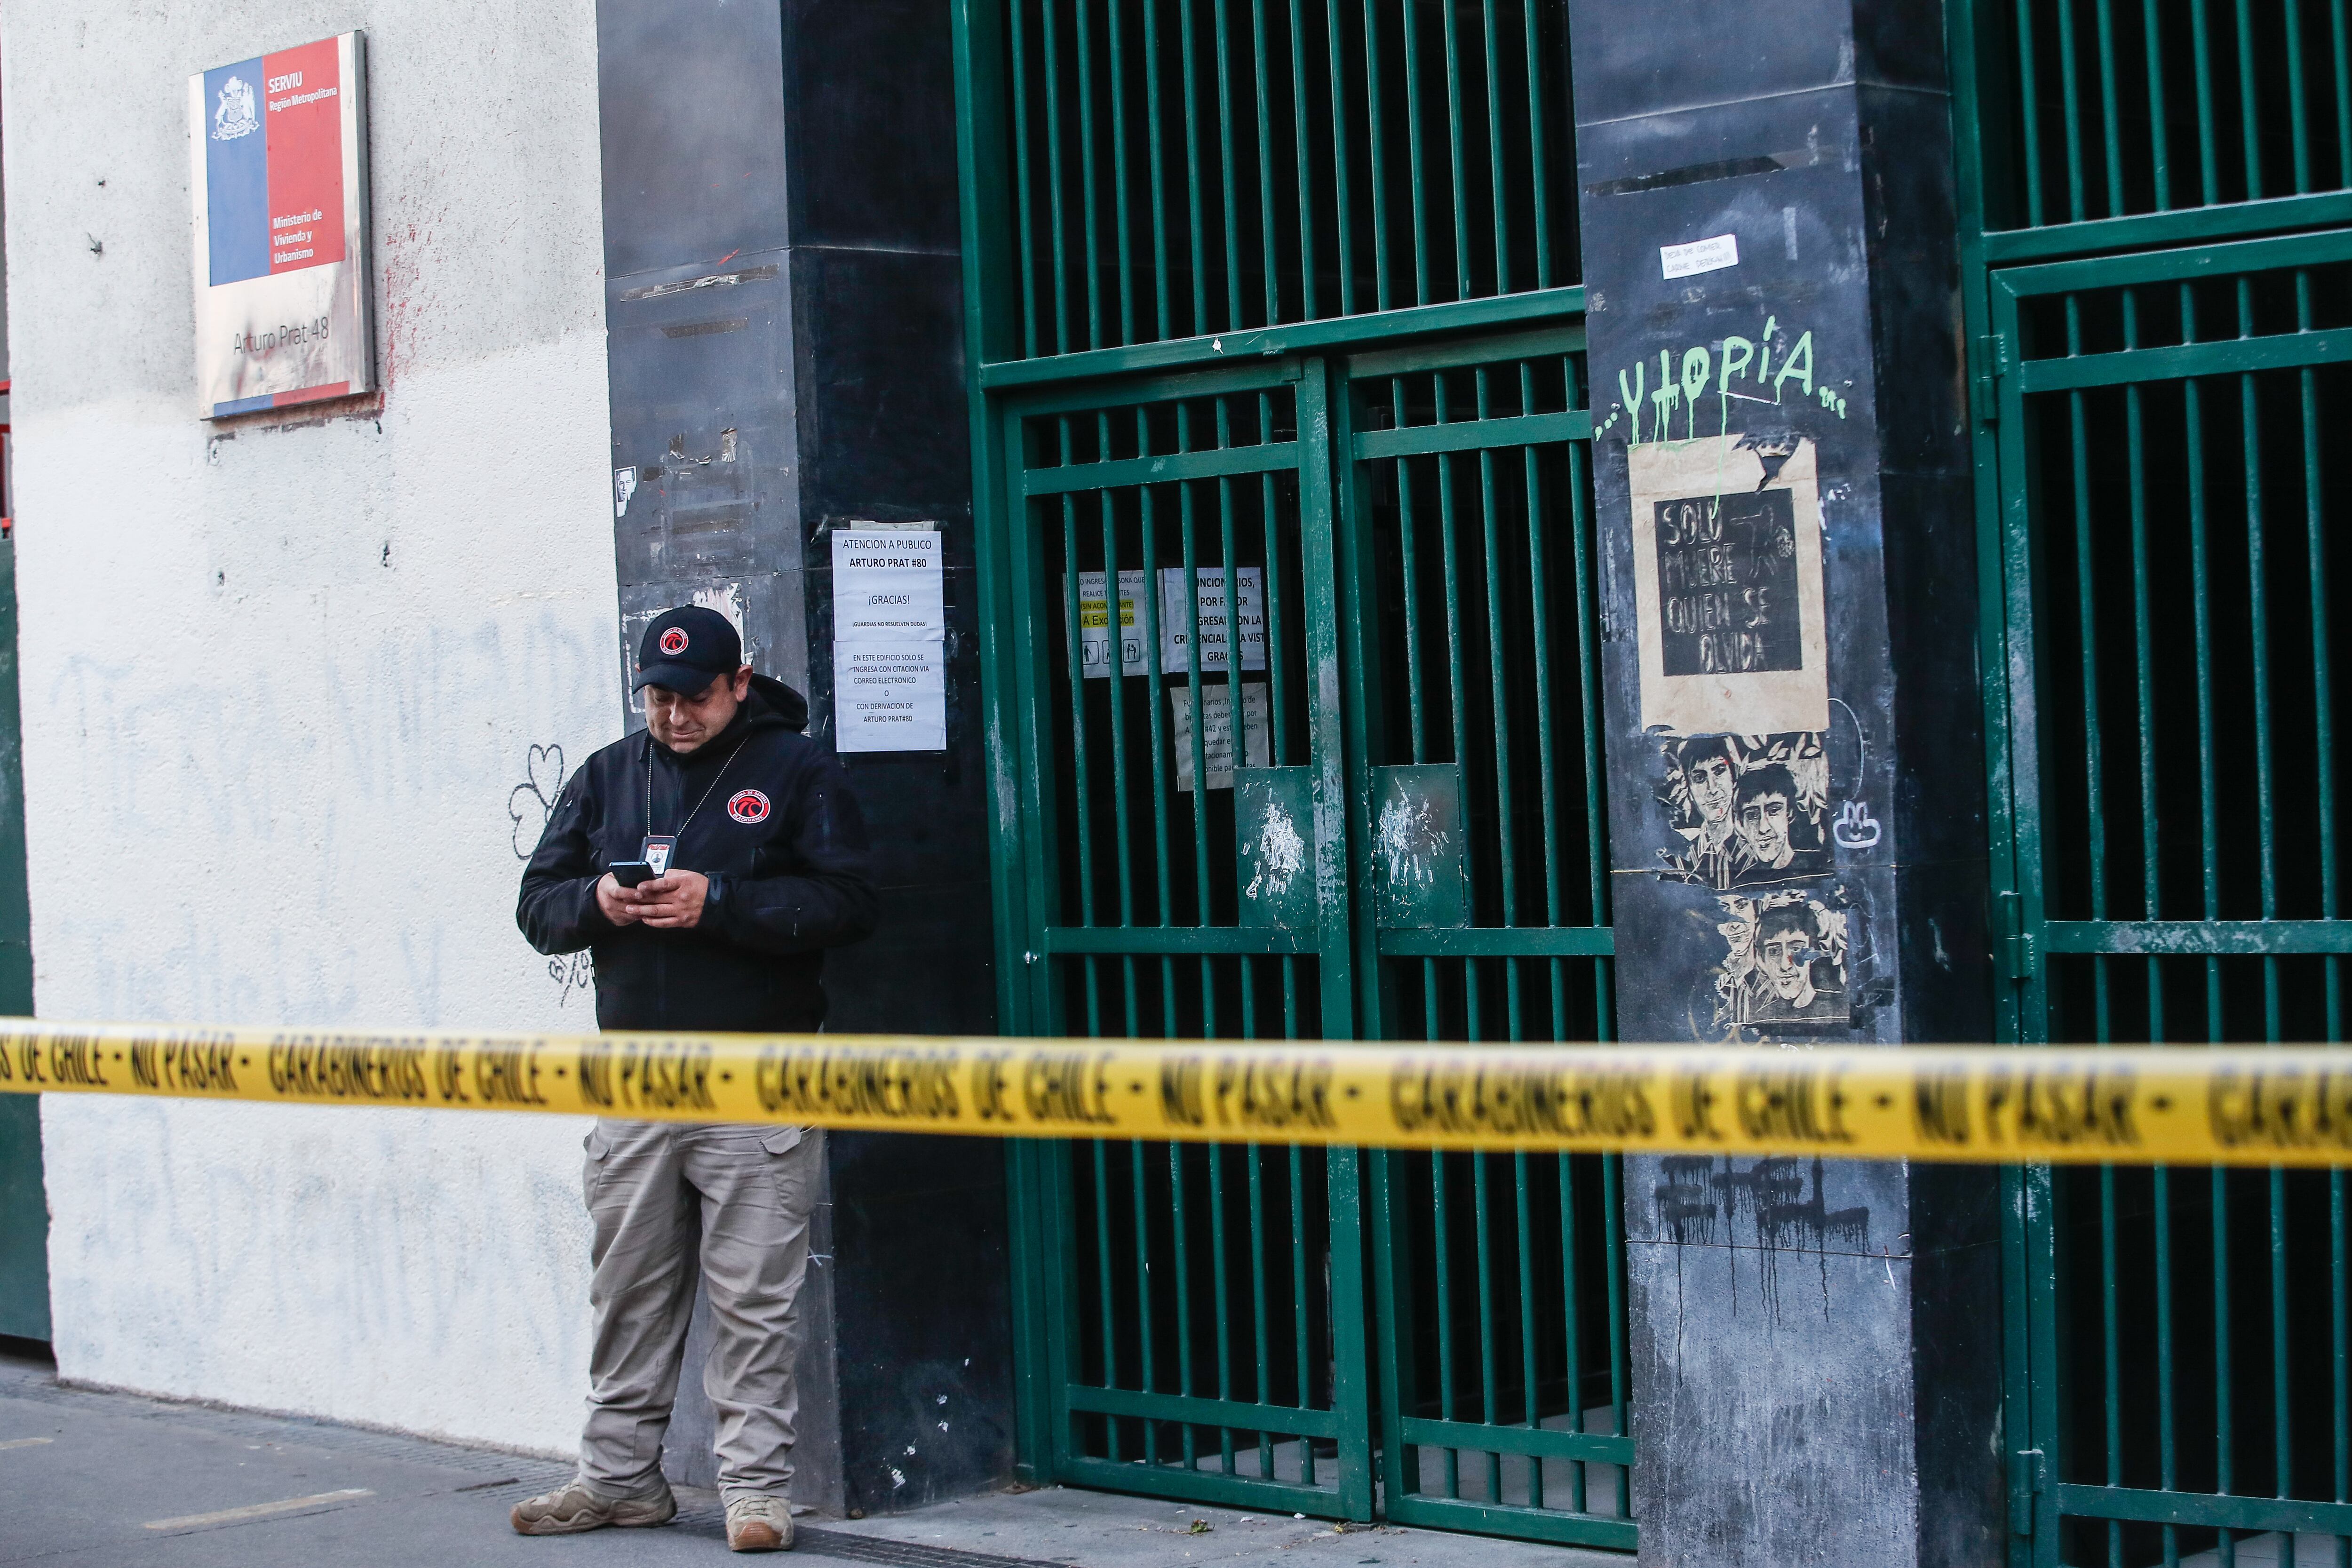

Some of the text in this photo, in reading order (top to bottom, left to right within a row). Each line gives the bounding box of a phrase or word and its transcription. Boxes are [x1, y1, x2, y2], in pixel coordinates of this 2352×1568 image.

[268, 71, 303, 94] SERVIU
[270, 87, 337, 112] Región Metropolitana
[273, 209, 322, 229] Ministerio de
[273, 230, 312, 247] Vivienda y
[274, 248, 314, 264] Urbanismo
[234, 317, 329, 355] Arturo Prat 48
[1663, 501, 1723, 546] SOLO
[843, 540, 932, 549] ATENCION A PUBLICO
[850, 558, 927, 567] ARTURO PRAT #80
[868, 595, 910, 605] ¡GRACIAS!
[1200, 597, 1217, 606] POR
[1743, 587, 1771, 629] SE
[1083, 616, 1089, 625] A
[1252, 616, 1262, 625] LA
[1204, 738, 1225, 747] quedar
[732, 813, 764, 822] BLACKHAWK
[52, 1029, 109, 1086] CHILE
[165, 1030, 238, 1091] PASAR
[269, 1032, 427, 1100] CARABINEROS
[436, 1038, 471, 1102] DE
[475, 1038, 549, 1106] CHILE
[621, 1042, 717, 1111] PASAR
[755, 1043, 960, 1119] CARABINEROS
[1023, 1049, 1117, 1125] CHILE
[1214, 1052, 1340, 1129] PASAR
[1390, 1055, 1657, 1140] CARABINEROS
[1735, 1059, 1859, 1144] CHILE
[1979, 1058, 2143, 1146] PASAR
